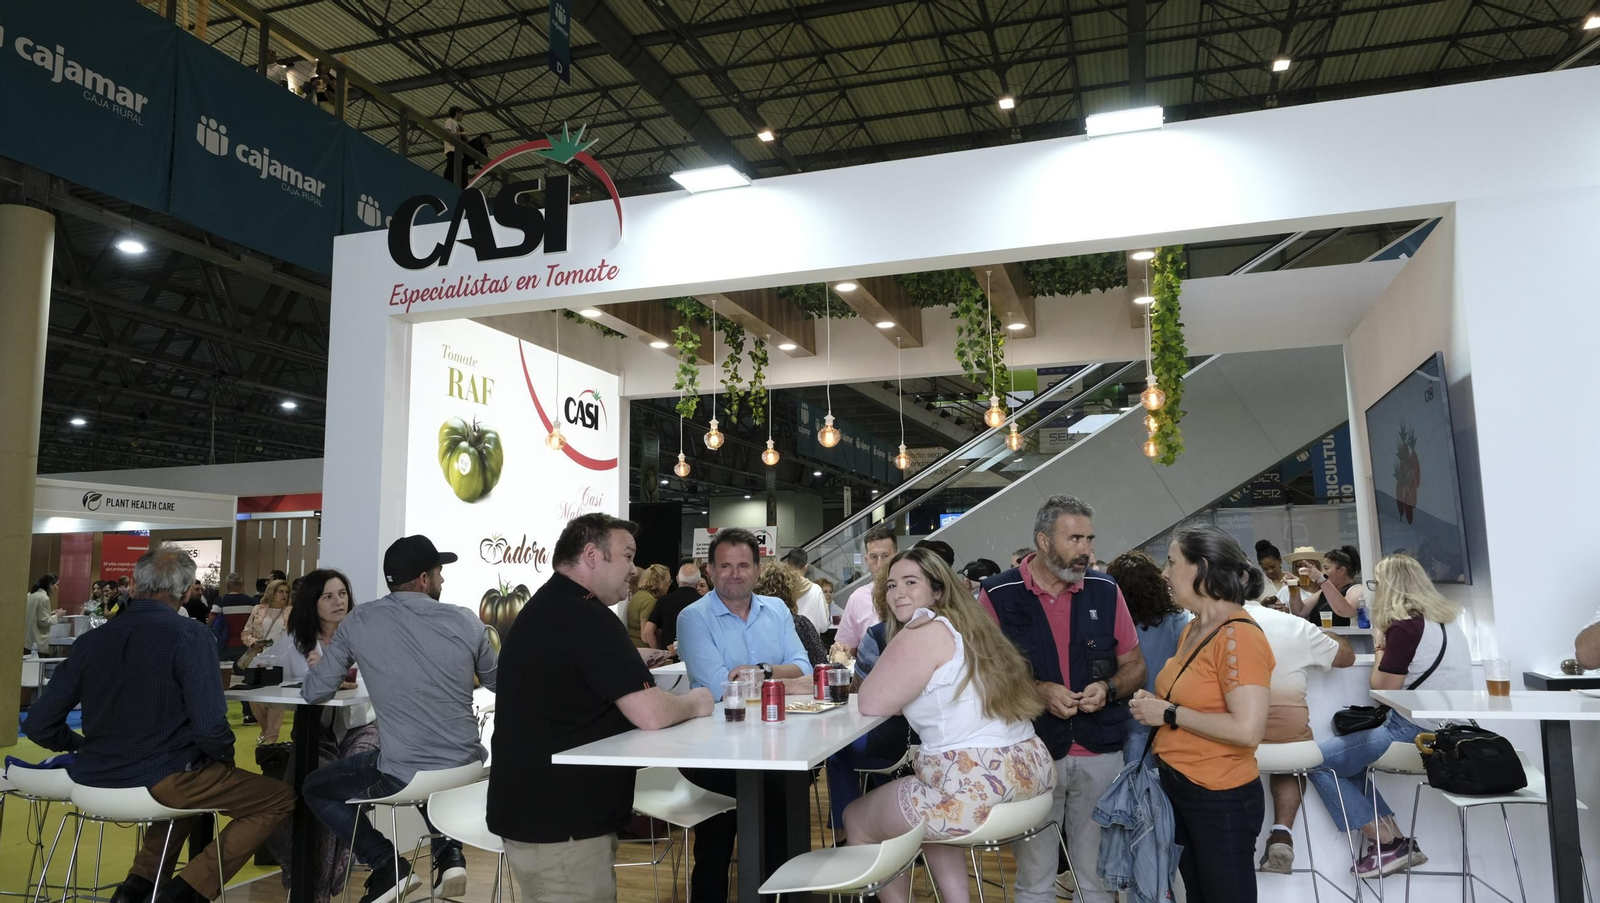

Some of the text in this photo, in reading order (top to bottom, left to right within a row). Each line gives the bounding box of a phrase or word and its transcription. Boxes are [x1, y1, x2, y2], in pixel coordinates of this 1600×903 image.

[15, 36, 149, 114] cajamar
[556, 61, 563, 74] D
[83, 91, 144, 126] CAJA RURAL
[235, 143, 326, 197] cajamar
[281, 183, 323, 208] CAJA RURAL
[388, 174, 571, 270] CASI
[389, 259, 620, 313] Especialistas en Tomate
[442, 343, 479, 368] Tomate
[447, 366, 496, 406] RAF
[564, 396, 599, 431] CASI
[106, 497, 176, 512] PLANT HEALTH CARE
